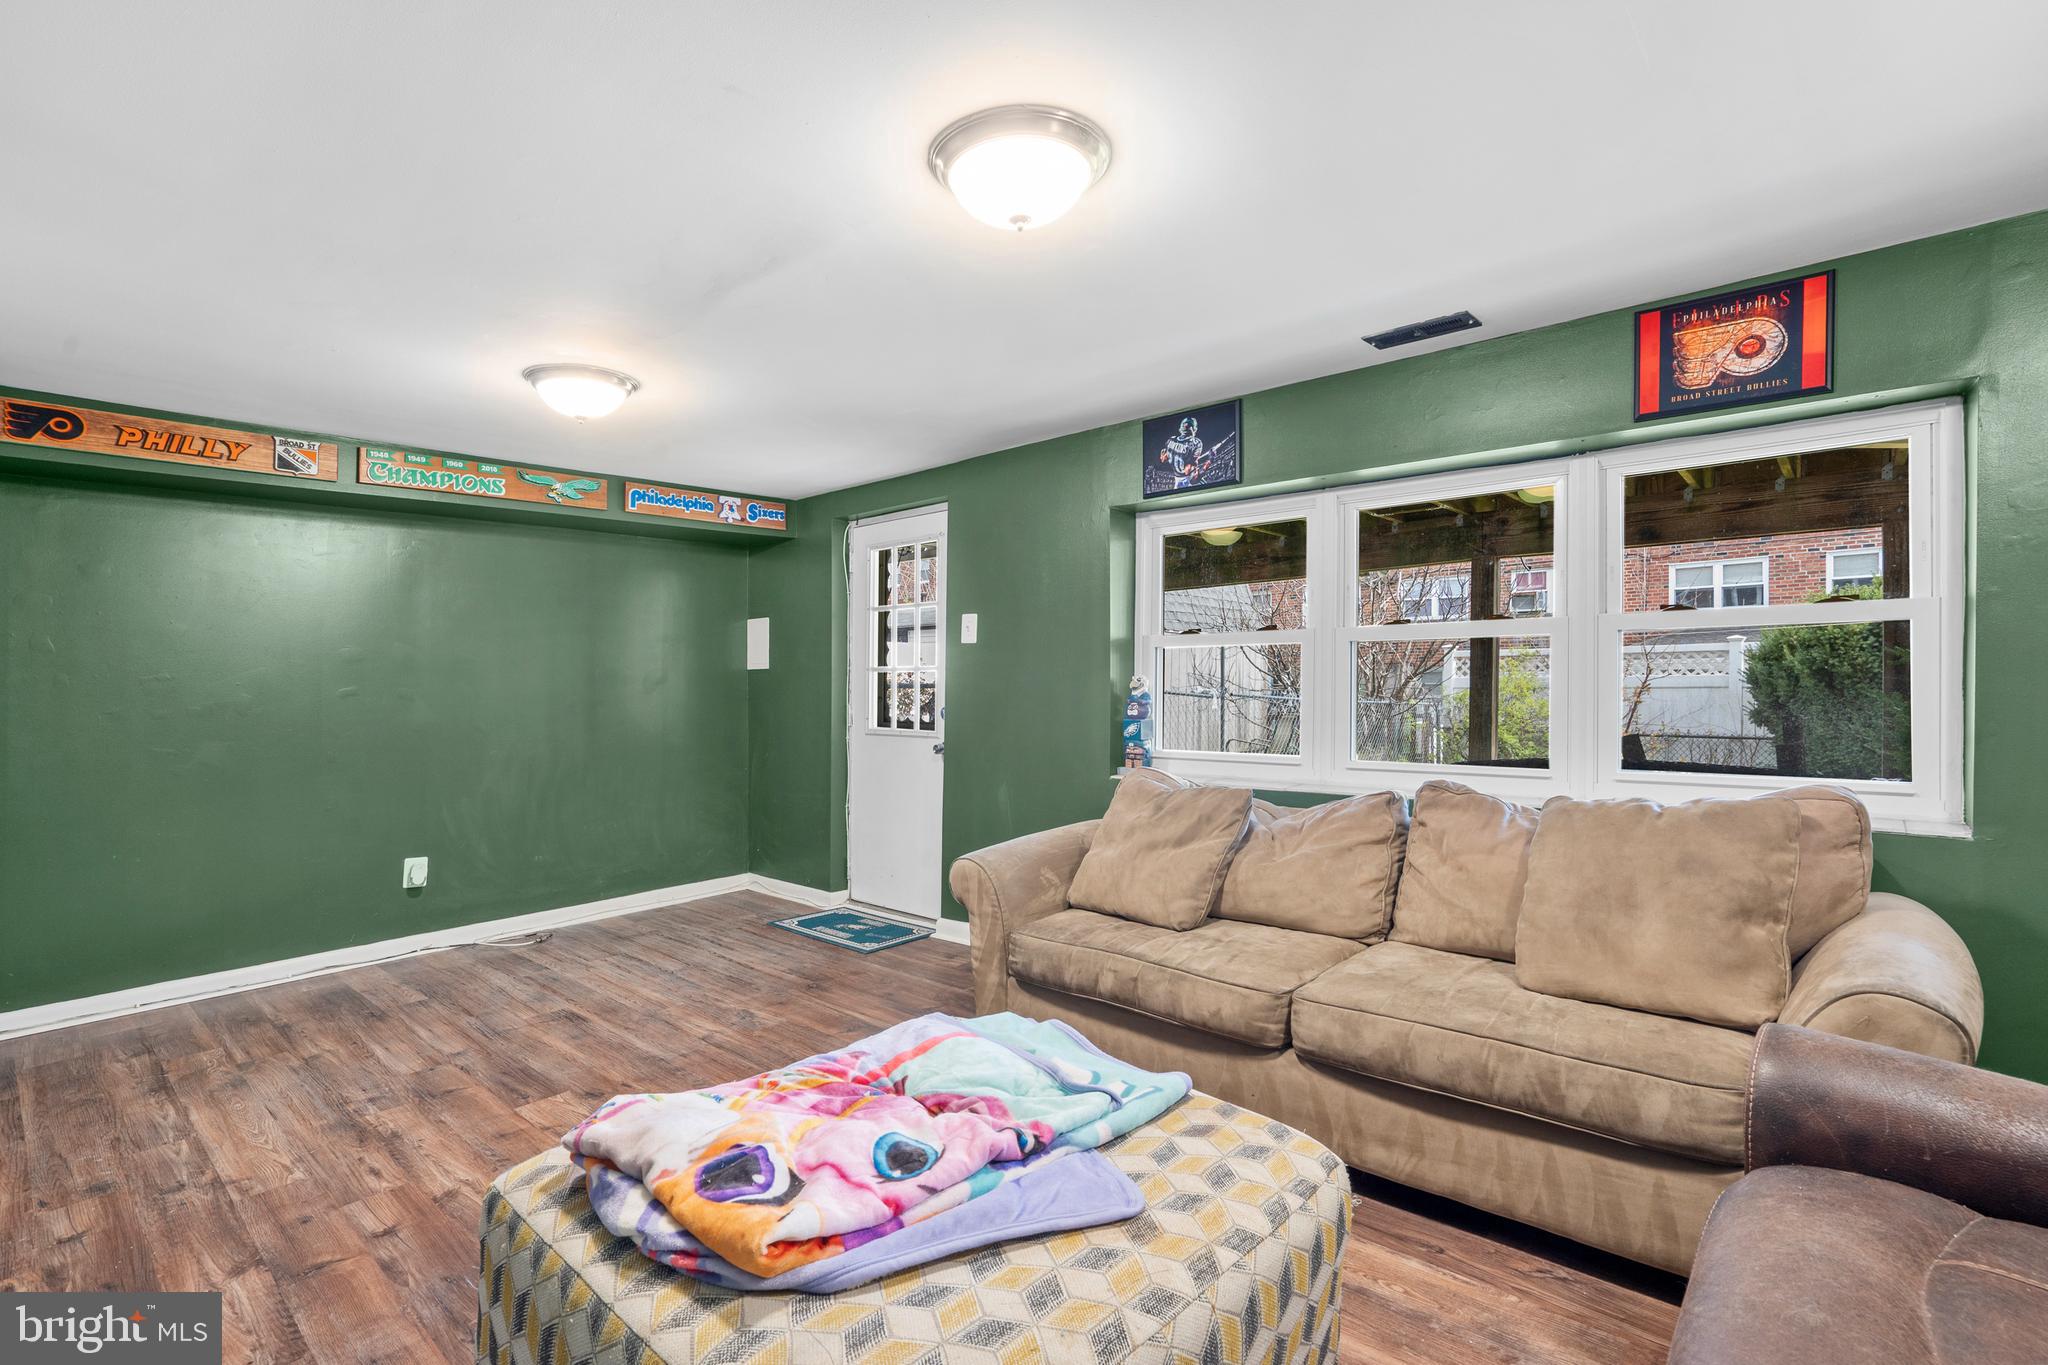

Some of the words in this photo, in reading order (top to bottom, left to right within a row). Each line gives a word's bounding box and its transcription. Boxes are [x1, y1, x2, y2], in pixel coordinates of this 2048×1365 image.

[1671, 392, 1701, 403] BROAD
[1705, 386, 1741, 397] STREET
[1746, 377, 1789, 391] BULLIES
[113, 424, 252, 462] PHILLY
[279, 438, 305, 449] BROAD
[307, 443, 316, 451] ST
[282, 447, 313, 470] BULLIES
[408, 454, 426, 463] 1949
[746, 502, 785, 523] Sixers
